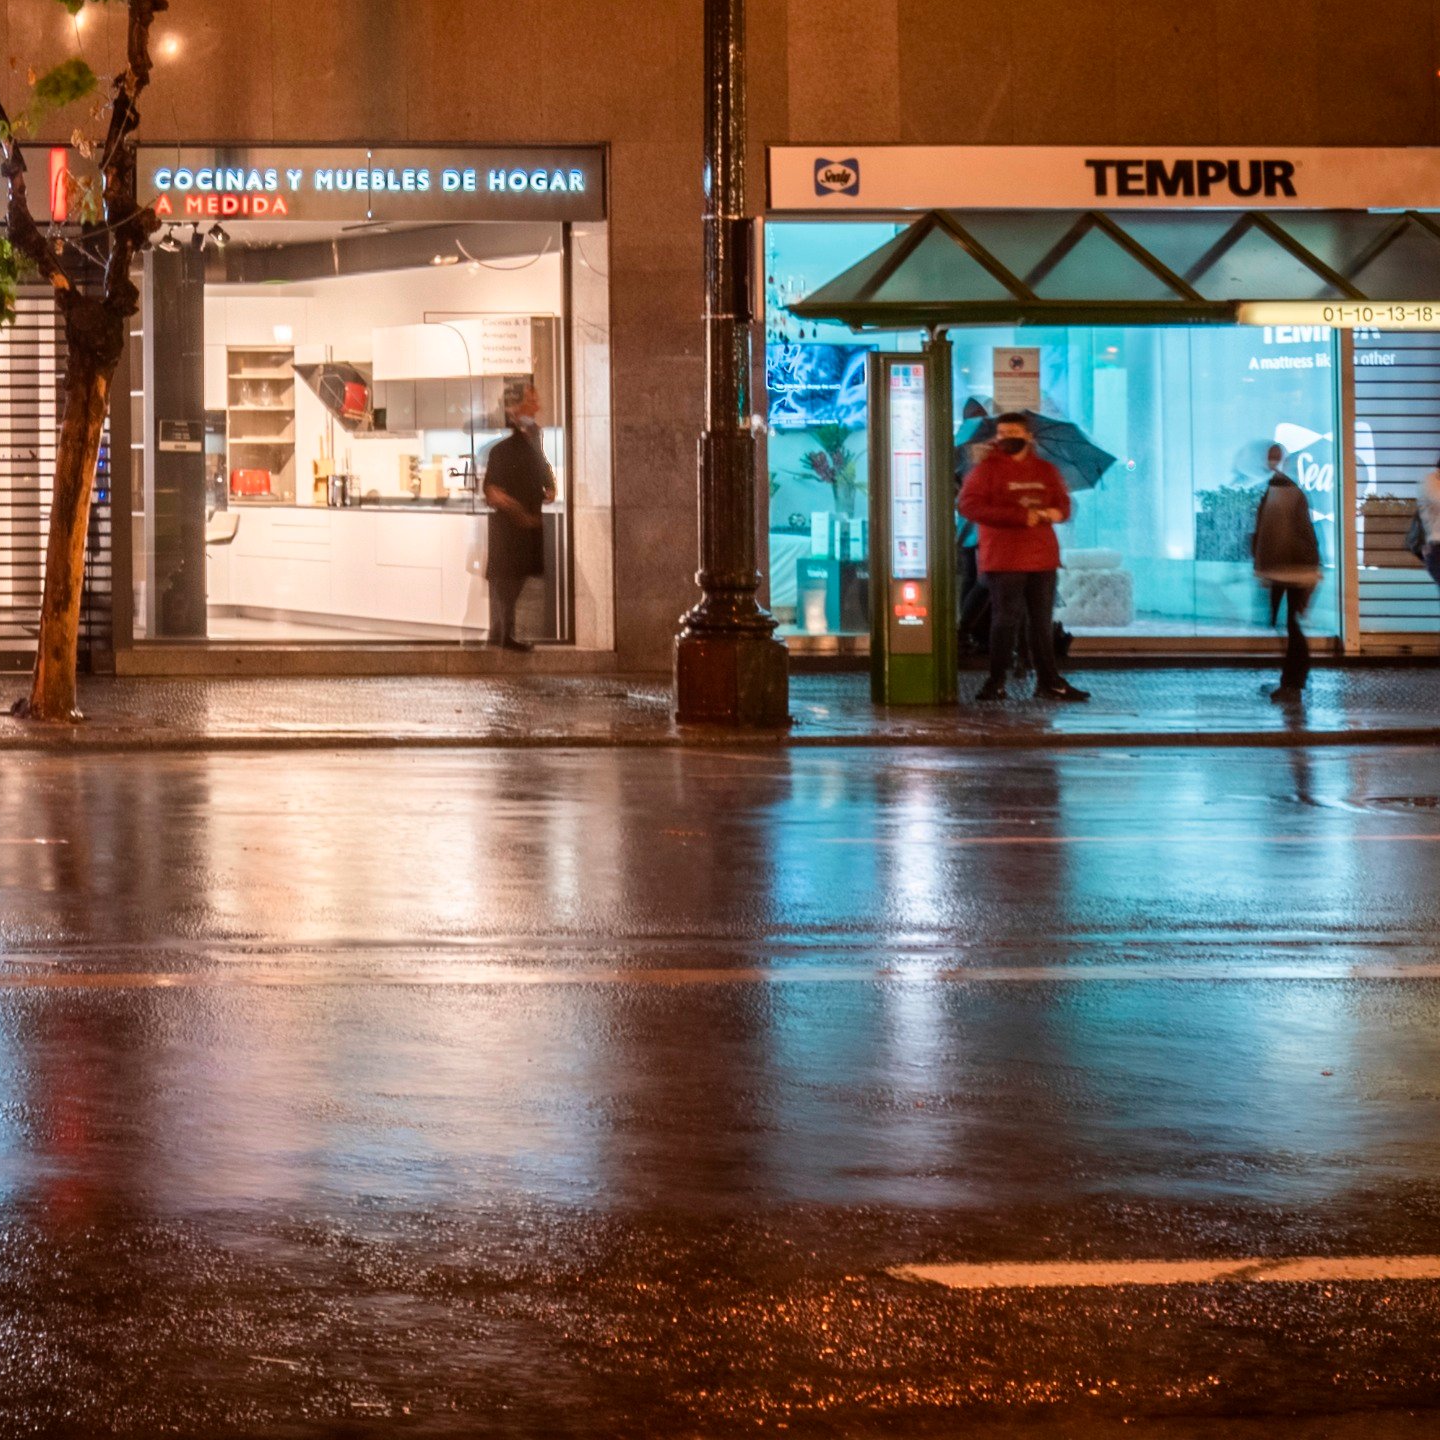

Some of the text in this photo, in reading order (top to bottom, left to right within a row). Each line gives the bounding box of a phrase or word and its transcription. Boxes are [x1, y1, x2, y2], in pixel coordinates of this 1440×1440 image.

[154, 168, 585, 191] COCINAS Y MUEBLES DE HOGAR
[820, 169, 851, 186] Sealy
[1085, 159, 1297, 197] TEMPUR
[155, 194, 288, 215] A MEDIDA
[1261, 356, 1314, 369] mattress
[1315, 352, 1331, 368] lik
[1361, 351, 1396, 366] other
